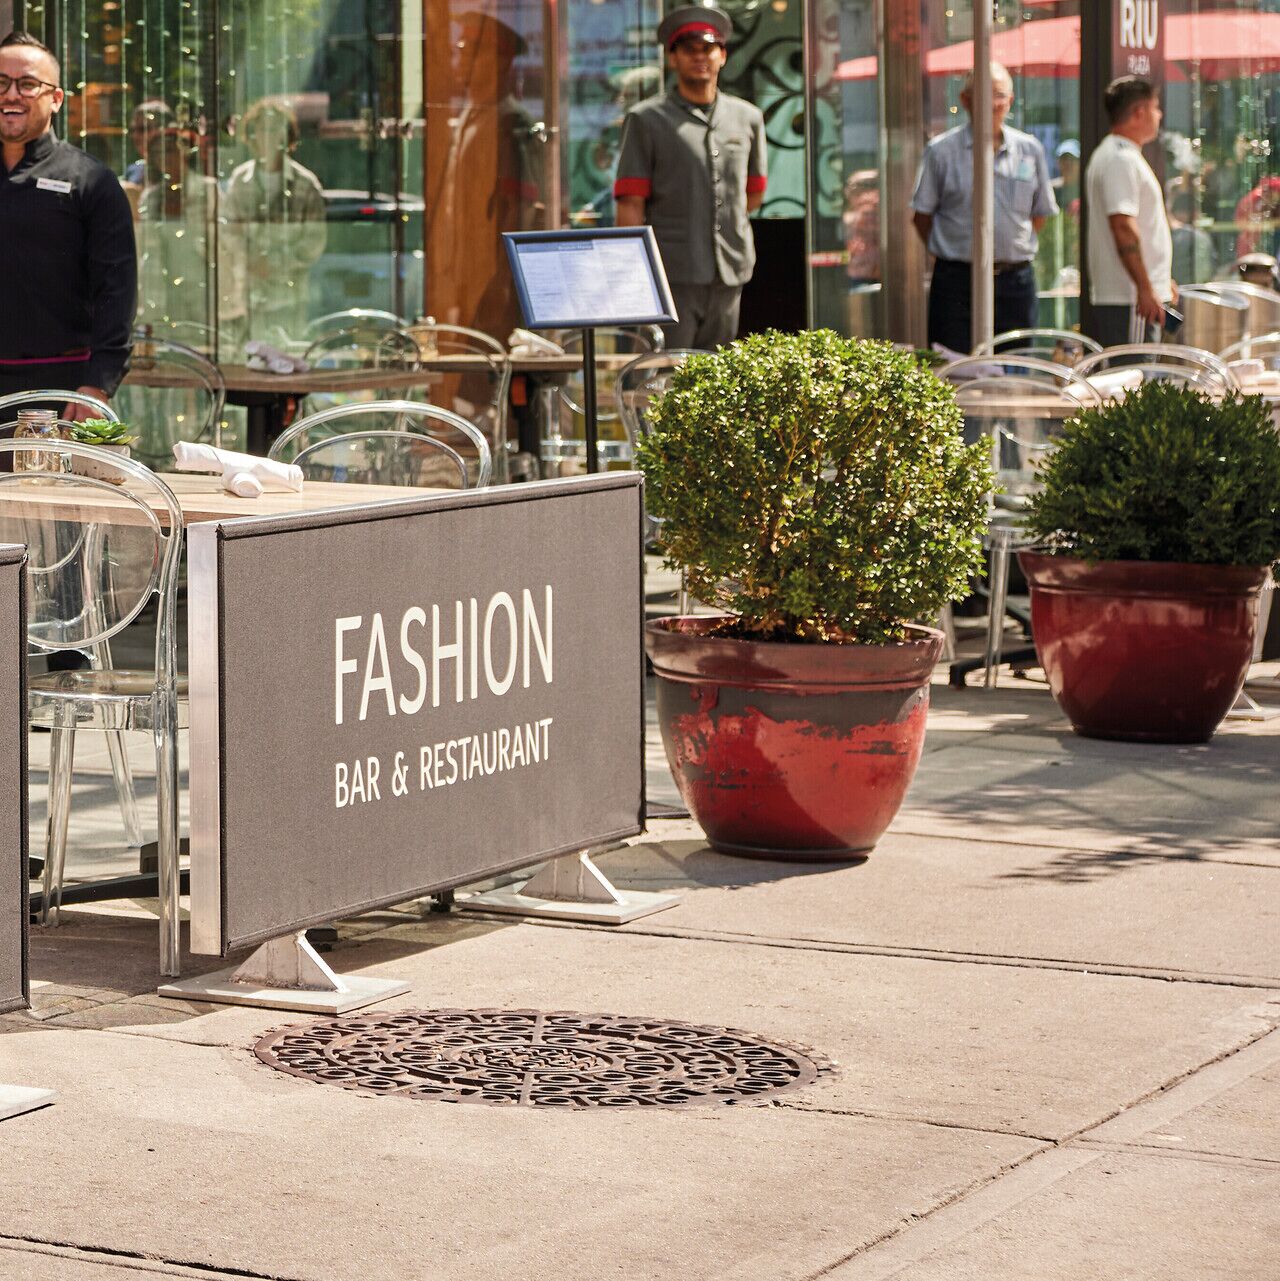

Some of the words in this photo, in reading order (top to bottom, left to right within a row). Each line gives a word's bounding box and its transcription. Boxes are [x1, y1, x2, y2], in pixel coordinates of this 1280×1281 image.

[335, 584, 554, 725] FASHION
[335, 756, 381, 809] BAR
[391, 750, 410, 797] &
[420, 718, 554, 792] RESTAURANT
